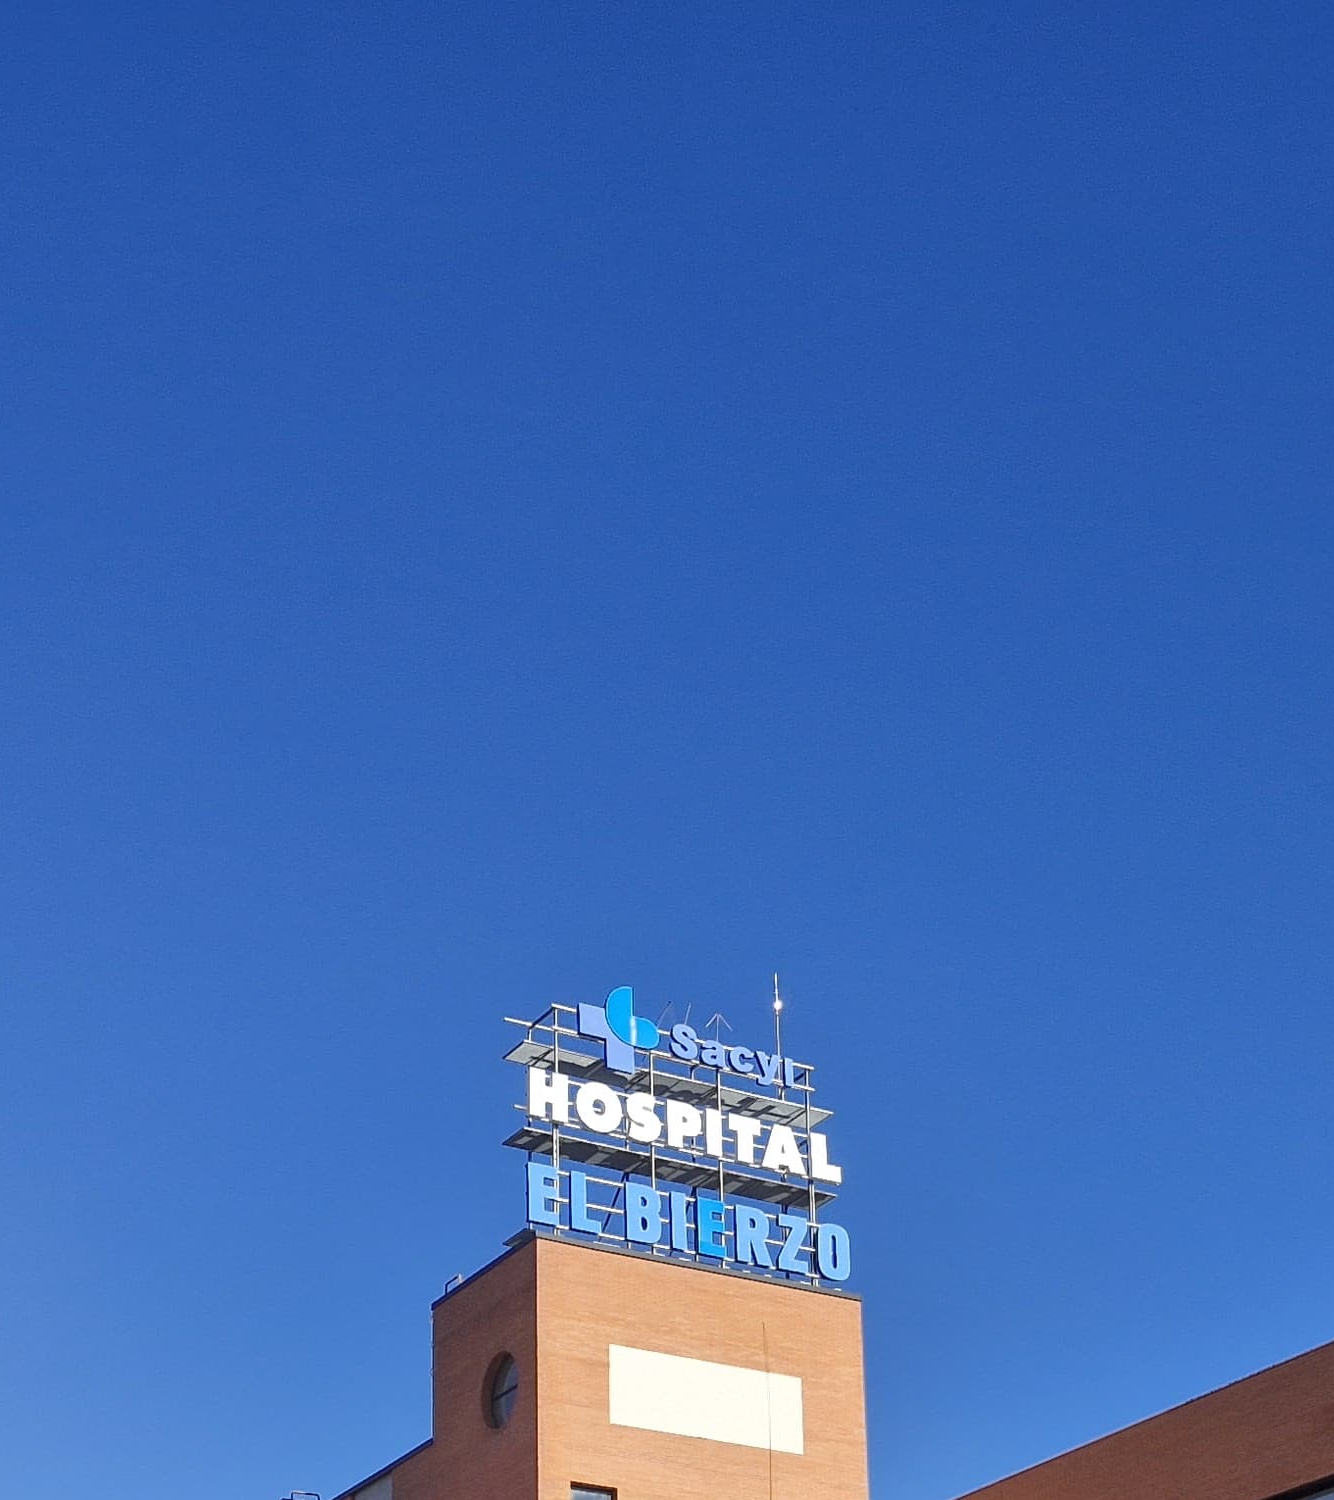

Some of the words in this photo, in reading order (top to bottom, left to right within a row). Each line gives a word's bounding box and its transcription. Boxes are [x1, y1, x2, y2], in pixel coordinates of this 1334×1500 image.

[670, 1024, 794, 1086] Sacyl
[529, 1067, 842, 1184] HOSPITAL
[527, 1162, 601, 1234] EL
[625, 1182, 850, 1281] BIERZO
